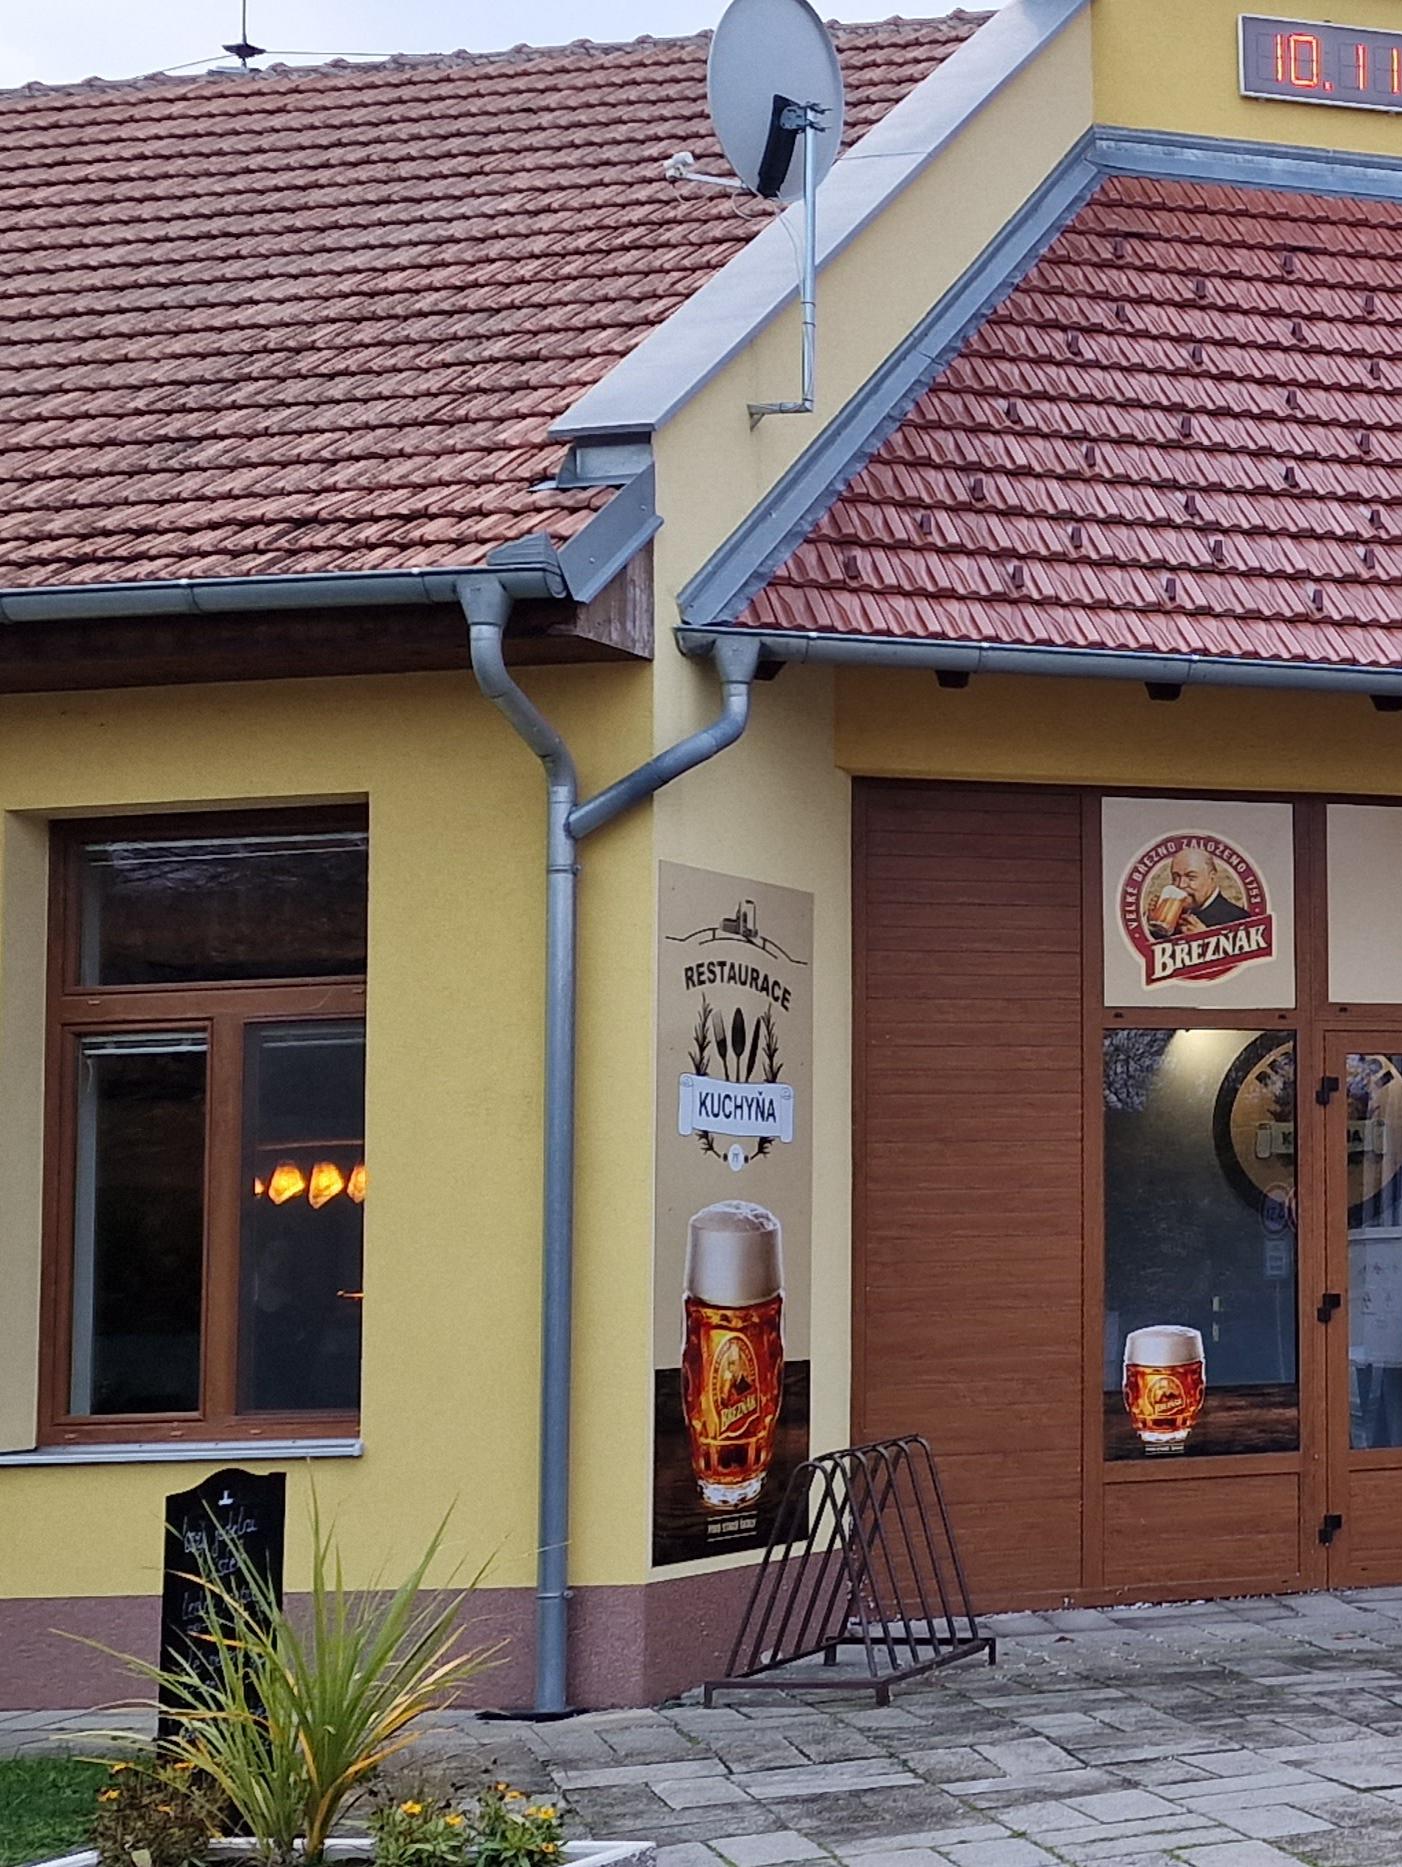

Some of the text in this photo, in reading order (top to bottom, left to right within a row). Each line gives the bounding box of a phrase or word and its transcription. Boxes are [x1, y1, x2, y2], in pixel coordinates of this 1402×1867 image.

[1125, 887, 1138, 930] VELKÉ
[1151, 925, 1268, 979] BŘEZŇÁK
[684, 960, 792, 1012] RESTAURACE
[699, 1091, 777, 1123] KUCHYŇA
